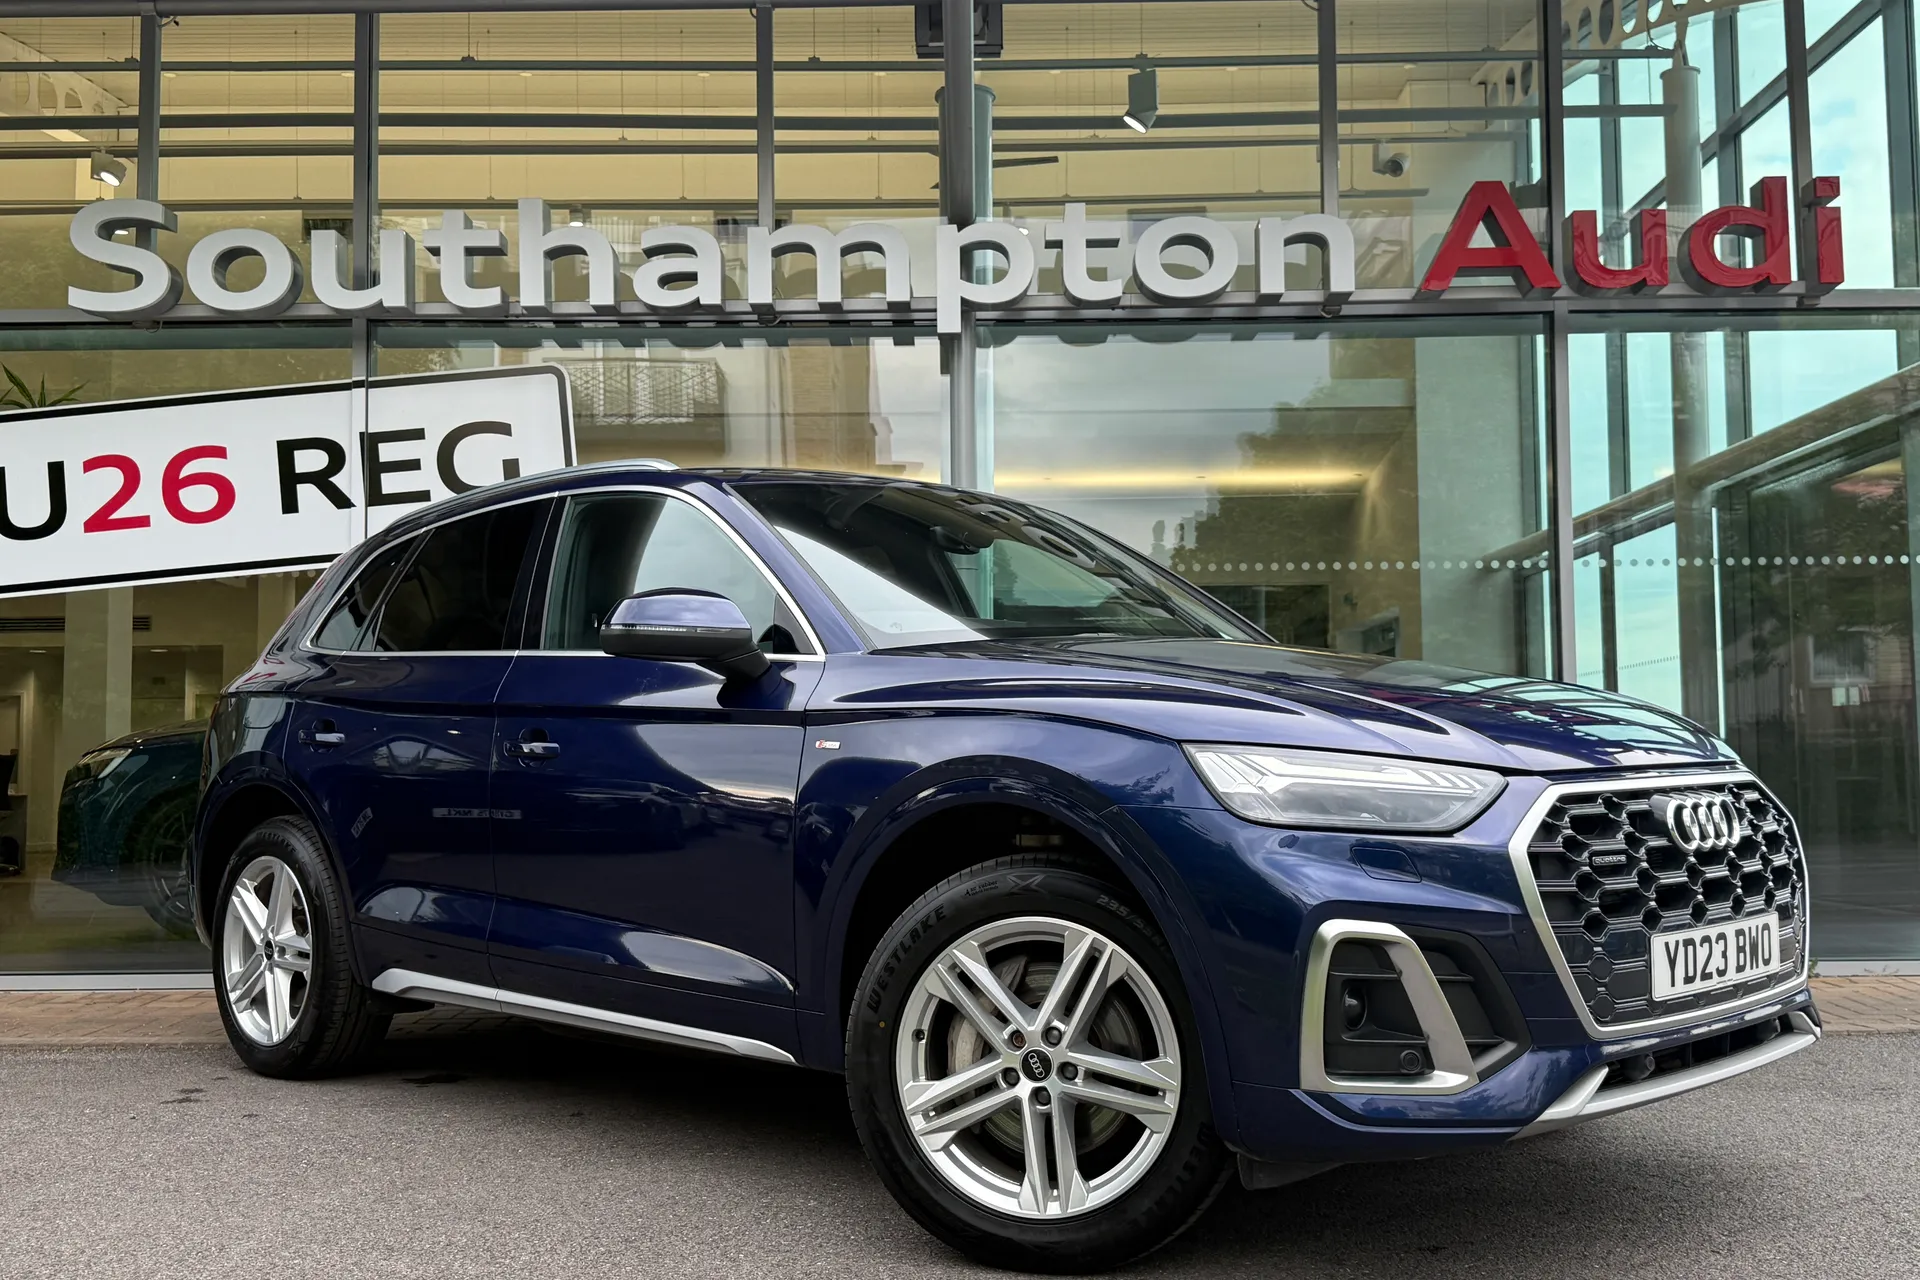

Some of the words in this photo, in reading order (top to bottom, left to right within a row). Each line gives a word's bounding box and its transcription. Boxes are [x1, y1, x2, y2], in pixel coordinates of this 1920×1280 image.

[67, 198, 1355, 334] Southampton
[1418, 176, 1845, 295] Audi
[276, 420, 521, 515] REG
[1593, 856, 1627, 865] quattro
[866, 902, 947, 1014] WESTLAKE
[1664, 932, 1728, 988] YD23
[1734, 922, 1772, 974] BWO
